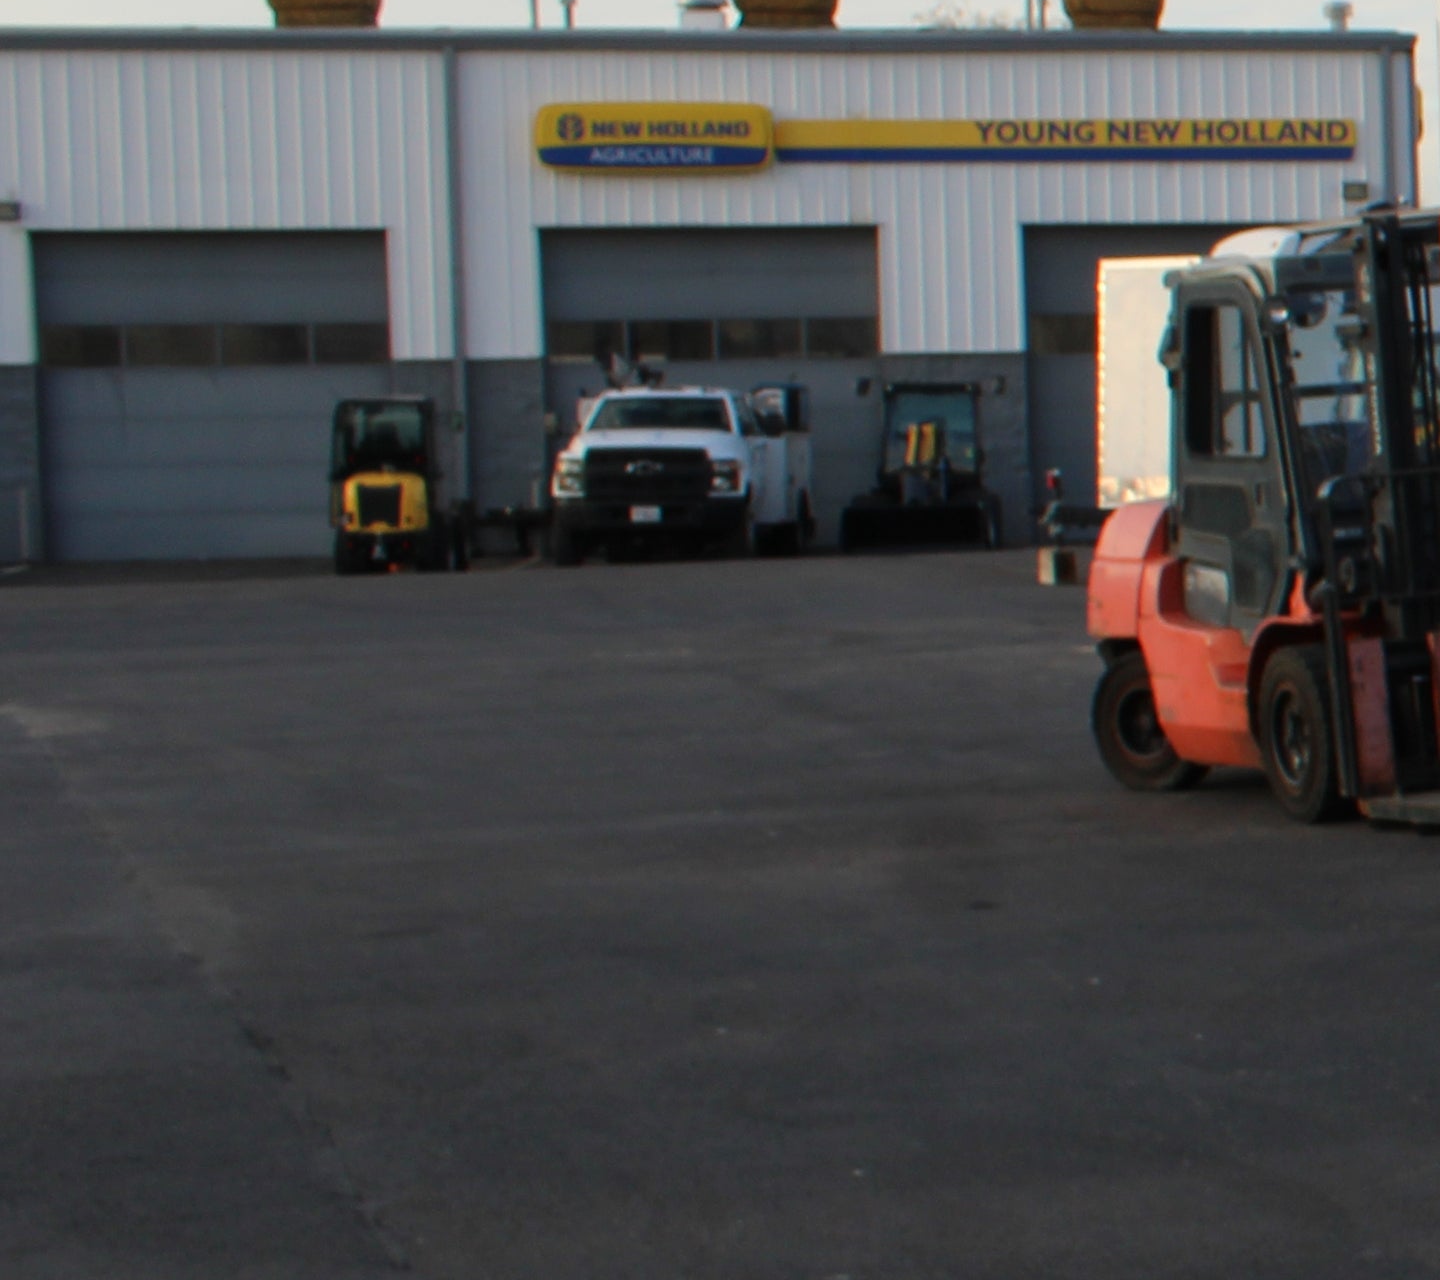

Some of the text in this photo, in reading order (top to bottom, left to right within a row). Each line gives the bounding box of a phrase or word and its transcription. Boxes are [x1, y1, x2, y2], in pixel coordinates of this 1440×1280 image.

[591, 121, 750, 137] NEW HOLLAND
[976, 120, 1349, 143] YOUNG NEW HOLLAND
[589, 147, 715, 164] AGRICULTURE
